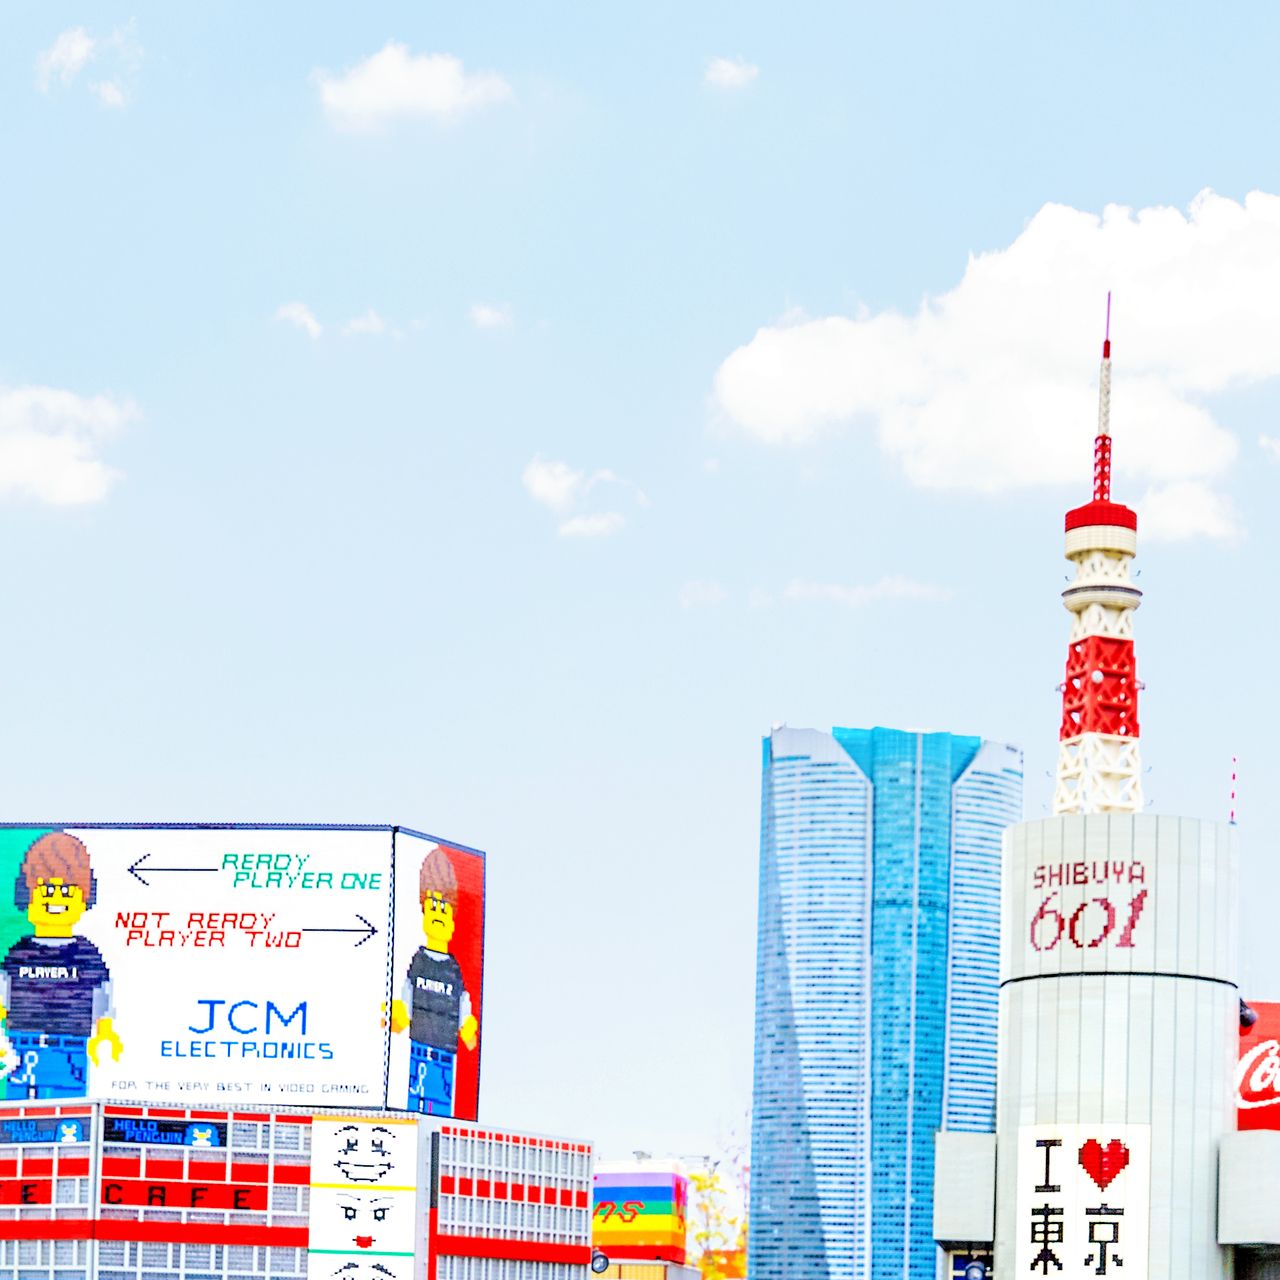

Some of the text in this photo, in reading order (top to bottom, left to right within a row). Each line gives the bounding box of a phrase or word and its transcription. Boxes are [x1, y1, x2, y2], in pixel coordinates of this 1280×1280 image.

[222, 854, 310, 870] READY
[234, 872, 382, 889] PLAYER ONE
[1034, 861, 1145, 889] SHIBUYA
[115, 912, 275, 929] NOT READY
[1030, 889, 1148, 951] 601
[126, 931, 302, 948] PLAYER TWO
[19, 966, 68, 978] PLAYER
[188, 1000, 307, 1035] JCM
[161, 1041, 333, 1060] ELECTRONICS
[111, 1080, 137, 1090] FOR
[145, 1080, 170, 1091] THE
[178, 1081, 210, 1091] VERY
[216, 1082, 253, 1092] BEST
[260, 1082, 271, 1092] IN
[279, 1083, 315, 1093] VIDEO
[3, 1120, 36, 1132] HELLO
[113, 1120, 158, 1132] HELLO
[125, 1130, 183, 1144] PENGUIN
[1035, 1139, 1062, 1192] I
[105, 1184, 252, 1209] CAFE
[1030, 1203, 1124, 1275] 東京
